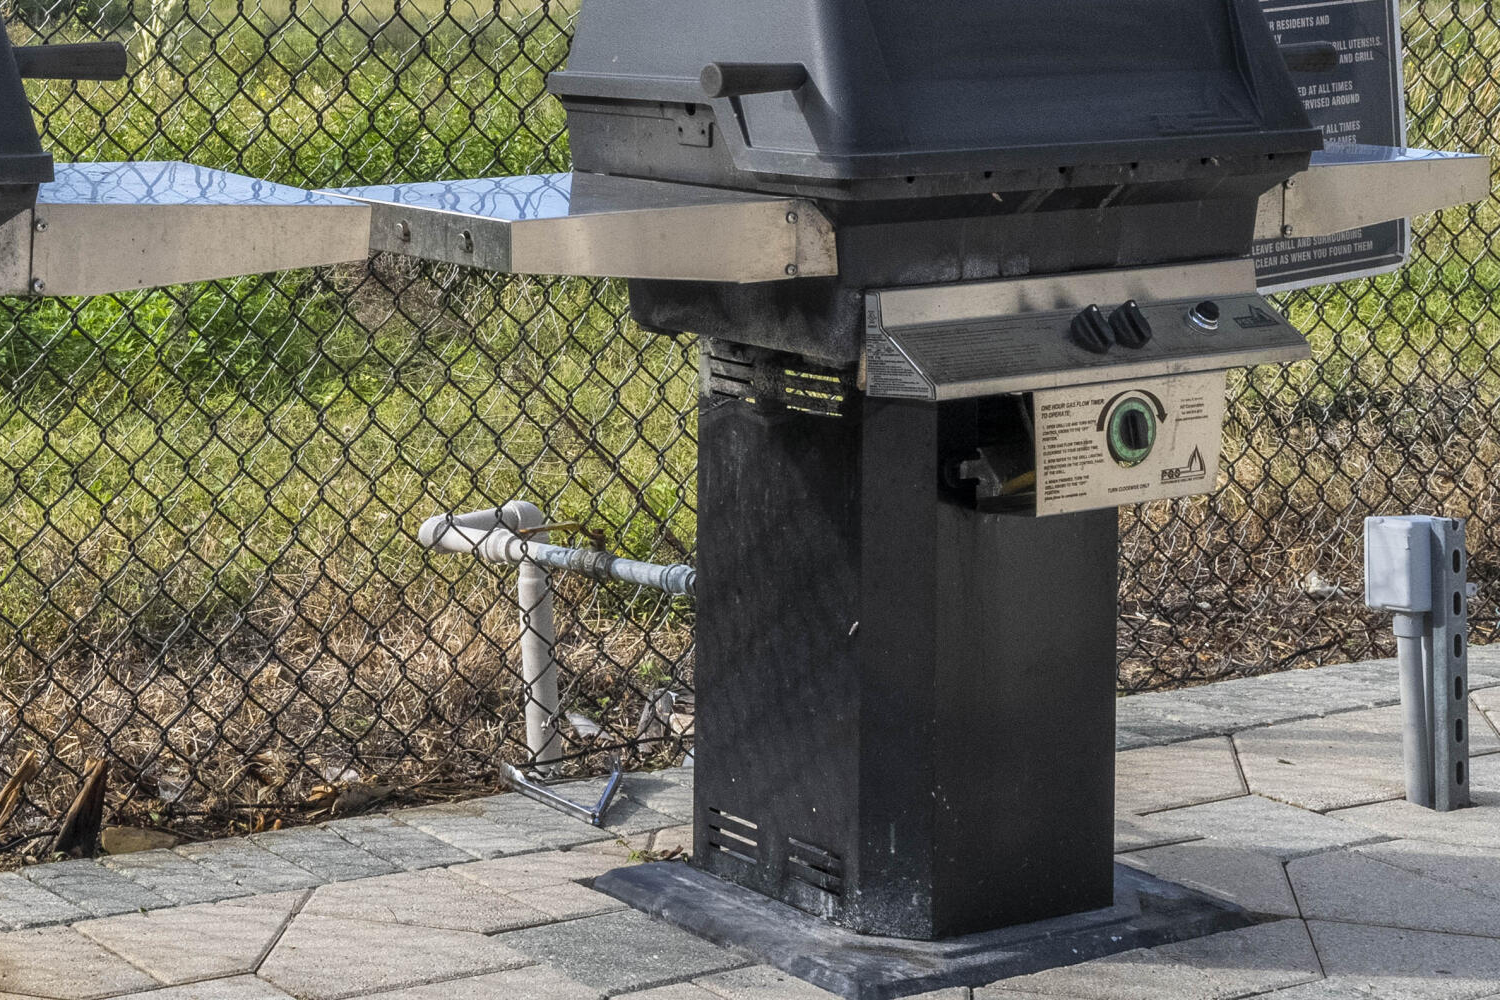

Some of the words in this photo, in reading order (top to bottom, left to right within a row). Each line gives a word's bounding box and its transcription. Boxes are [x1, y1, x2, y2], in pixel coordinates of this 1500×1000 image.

[1276, 16, 1314, 31] RESIDENTS
[1315, 15, 1330, 26] AND
[1339, 54, 1353, 64] AND
[1354, 51, 1374, 63] GRILL
[1297, 86, 1306, 96] ED
[1308, 85, 1317, 96] AT
[1318, 83, 1330, 94] ALL
[1331, 80, 1353, 92] TIMES
[1303, 96, 1329, 110] RVISED
[1331, 93, 1360, 106] AROUND
[1326, 123, 1338, 134] ALL
[1339, 120, 1361, 132] TIMES
[1252, 242, 1273, 256] LEAVE
[1275, 240, 1296, 251] GRILL
[1297, 237, 1312, 248] AND
[1255, 257, 1278, 269] CLEAN
[1280, 254, 1289, 265] AS
[1291, 252, 1312, 264] WHEN
[1313, 248, 1328, 260] YOU
[1329, 244, 1352, 257] FOUND
[1354, 240, 1373, 252] THEM
